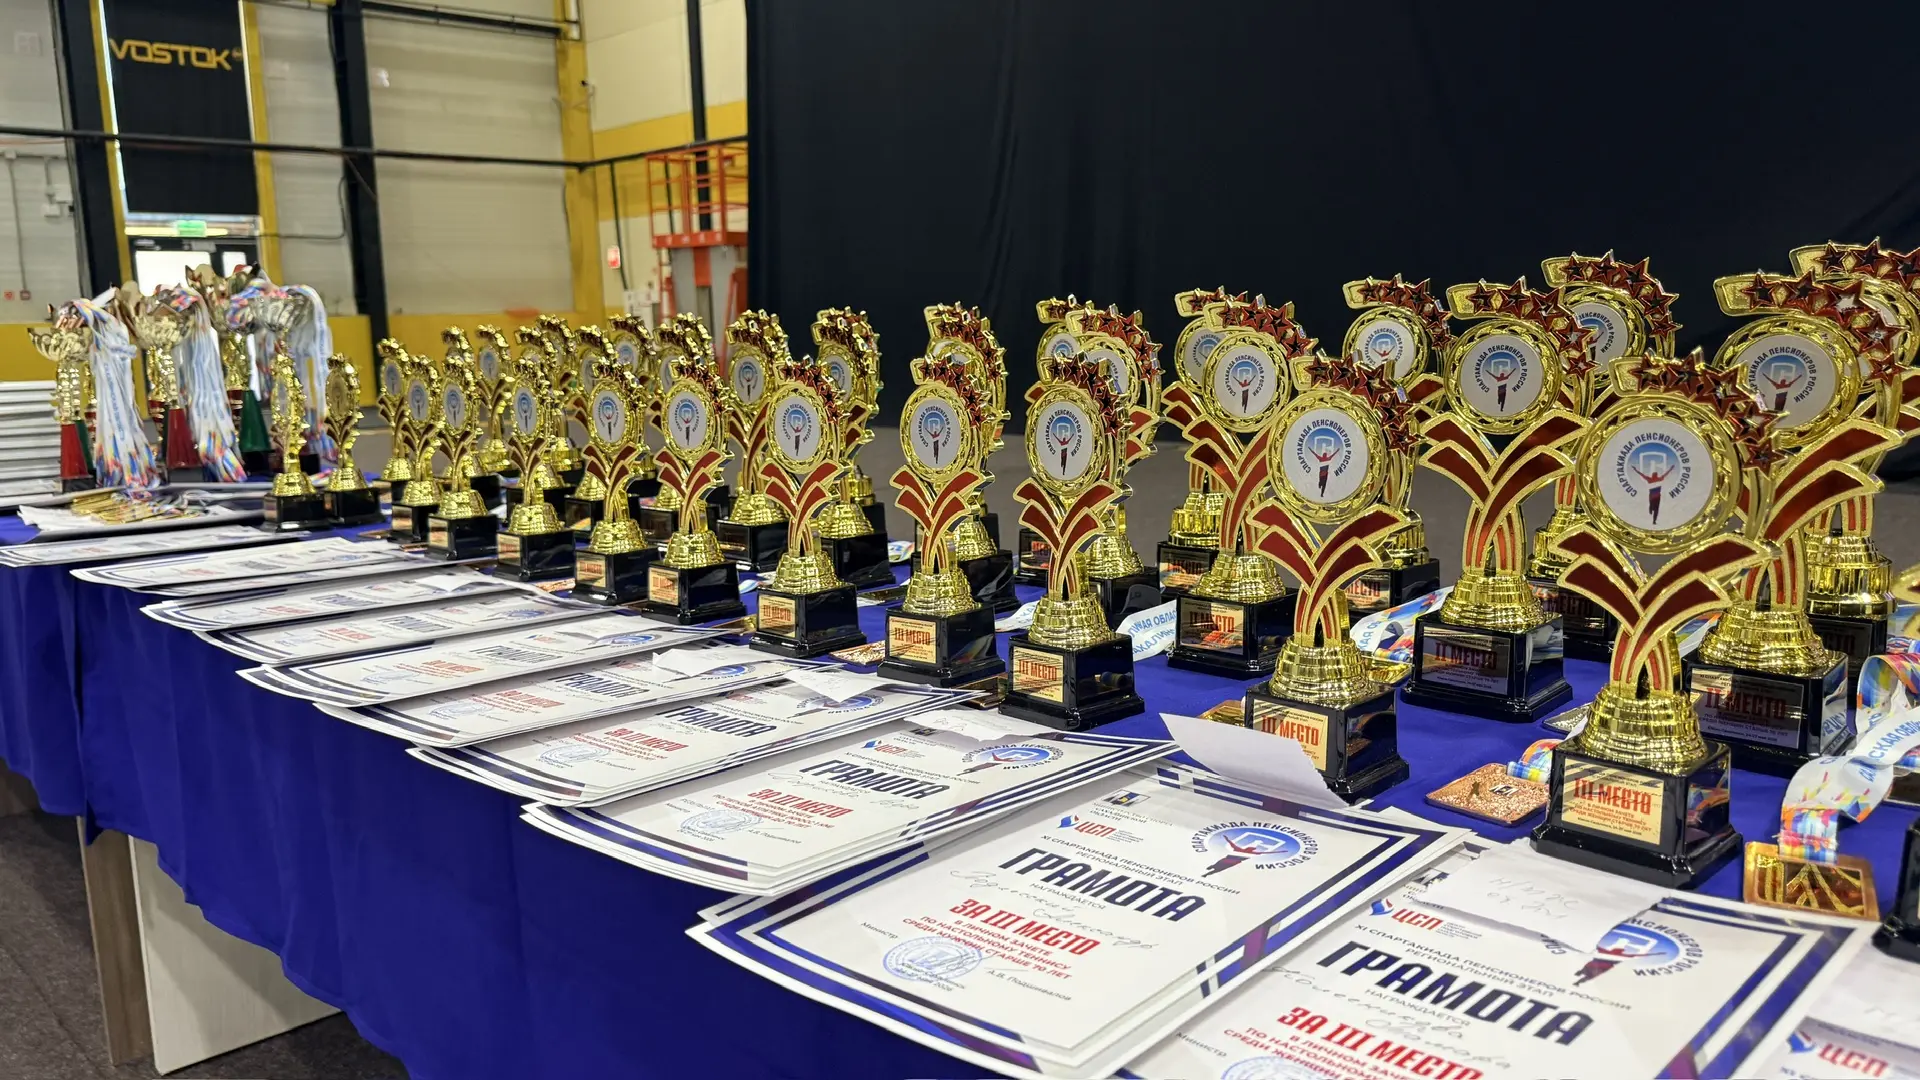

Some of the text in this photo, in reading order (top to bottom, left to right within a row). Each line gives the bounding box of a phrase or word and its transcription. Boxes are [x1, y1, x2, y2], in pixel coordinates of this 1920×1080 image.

[109, 37, 232, 70] VOSTOK
[1472, 344, 1528, 394] СПАРТАКИАДА ПЕНСИОНЕРОВ РОССИИ
[1769, 346, 1818, 404] ПЕНСИОНЕРОВ РОССИИ
[1297, 418, 1352, 478] СПАРТАКИАДА ПЕНСИОНЕРОВ РОССИИ
[1616, 432, 1692, 500] СПАРТАКИАДА ПЕНСИОНЕРОВ РОССИИ
[905, 630, 932, 646] МЕСТО
[1434, 642, 1498, 670] II МЕСТО
[1032, 661, 1058, 682] МЕСТО
[1705, 688, 1722, 710] II
[655, 705, 778, 738] ГРАМОТА
[1261, 714, 1276, 736] III
[1280, 719, 1320, 746] МЕСТО
[799, 759, 950, 800] ГРАМОТА
[1573, 777, 1596, 802] III
[1597, 782, 1652, 816] МЕСТО
[747, 788, 854, 820] ЗА III МЕСТО
[1074, 821, 1116, 838] ЦСП
[1191, 821, 1320, 870] СПАРТАКИАДА ПЕНСИОНЕРОВ РОССИИ
[998, 847, 1208, 922] ГРАМОТА
[1051, 837, 1118, 862] СПАРТАКИАДА
[1119, 857, 1196, 884] ПЕНСИОНЕРОВ
[1196, 879, 1242, 896] РОССИИ
[1076, 851, 1184, 886] РЕГИОНАЛЬНЫЙ ЭТАП
[1030, 883, 1108, 910] НАГРАЖДАЕТСЯ
[861, 921, 900, 940] Министр
[949, 898, 1100, 956] ЗА III МЕСТО
[1391, 908, 1444, 930] ЦСП
[902, 918, 940, 936] СРЕДИ
[985, 948, 1030, 968] СТАРШЕ
[1047, 969, 1074, 980] ЛЕТ
[920, 916, 1072, 970] ПО НАСТОЛЬНОМУ ТЕННИСУ
[965, 922, 1012, 942] ЛИЧНОМ
[1011, 938, 1054, 958] ЗАЧЕТЕ
[1354, 924, 1368, 932] XI
[1369, 929, 1460, 962] СПАРТАКИАДА
[1463, 959, 1568, 998] ПЕНСИОНЕРОВ
[1570, 990, 1632, 1012] РОССИИ
[1405, 947, 1556, 998] РЕГИОНАЛЬНЫЙ ЭТАП
[1633, 958, 1700, 978] РОССИИ
[1316, 940, 1594, 1046] ГРАМОТА
[1365, 989, 1472, 1026] НАГРАЖДАЕТСЯ
[1176, 1031, 1228, 1058] Министр
[1246, 1027, 1268, 1040] ПО
[1277, 1006, 1330, 1034] ЗА
[1321, 1023, 1382, 1052] III
[1224, 1028, 1342, 1080] СРЕДИ ЖЕНЩИН
[1301, 1039, 1368, 1068] ЛИЧНОМ
[1818, 1043, 1890, 1078] ЦСП
